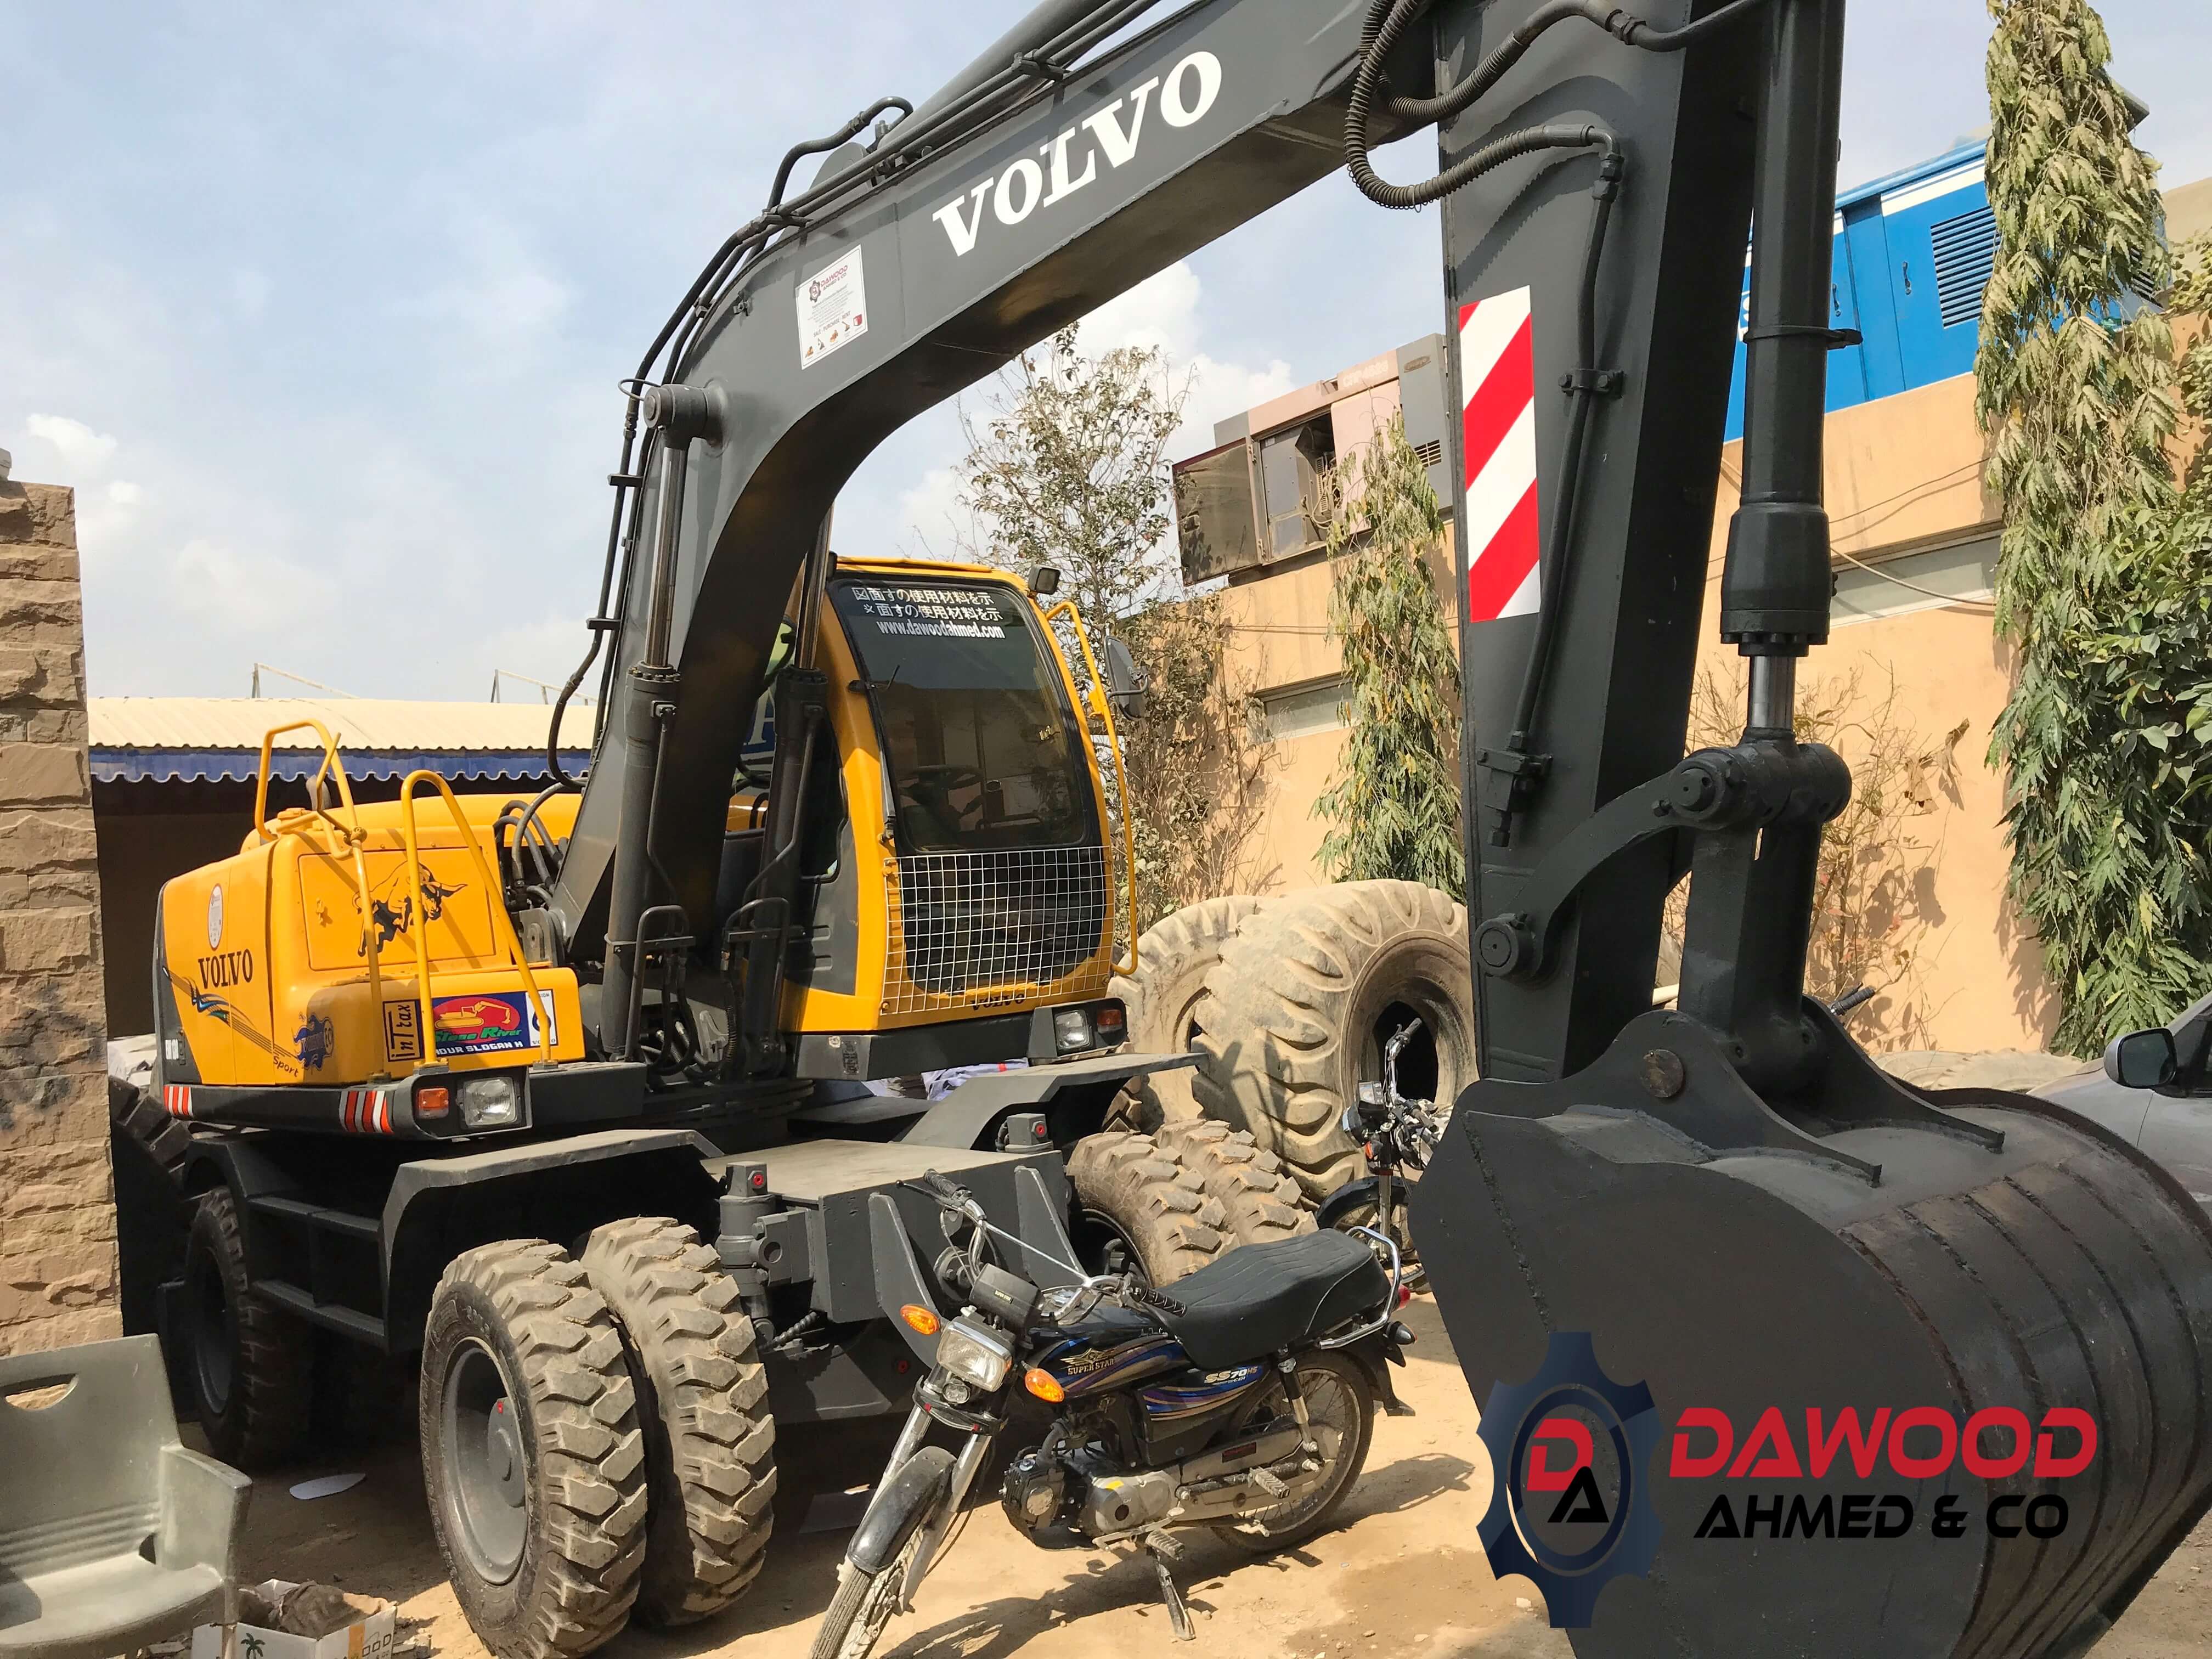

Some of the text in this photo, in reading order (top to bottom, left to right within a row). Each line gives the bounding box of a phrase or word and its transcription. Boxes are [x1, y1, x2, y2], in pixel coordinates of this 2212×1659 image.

[932, 51, 1222, 257] VOLVO
[820, 264, 848, 287] DAWOOD
[876, 619, 1006, 639] www.dawoodahmed.com
[198, 948, 253, 990] VOLVO
[969, 993, 1026, 1011] VOLVO
[480, 1026, 522, 1039] River
[466, 1042, 513, 1052] SLOGAN
[273, 1056, 299, 1077] Sport
[1068, 1357, 1114, 1375] SUPER STAR
